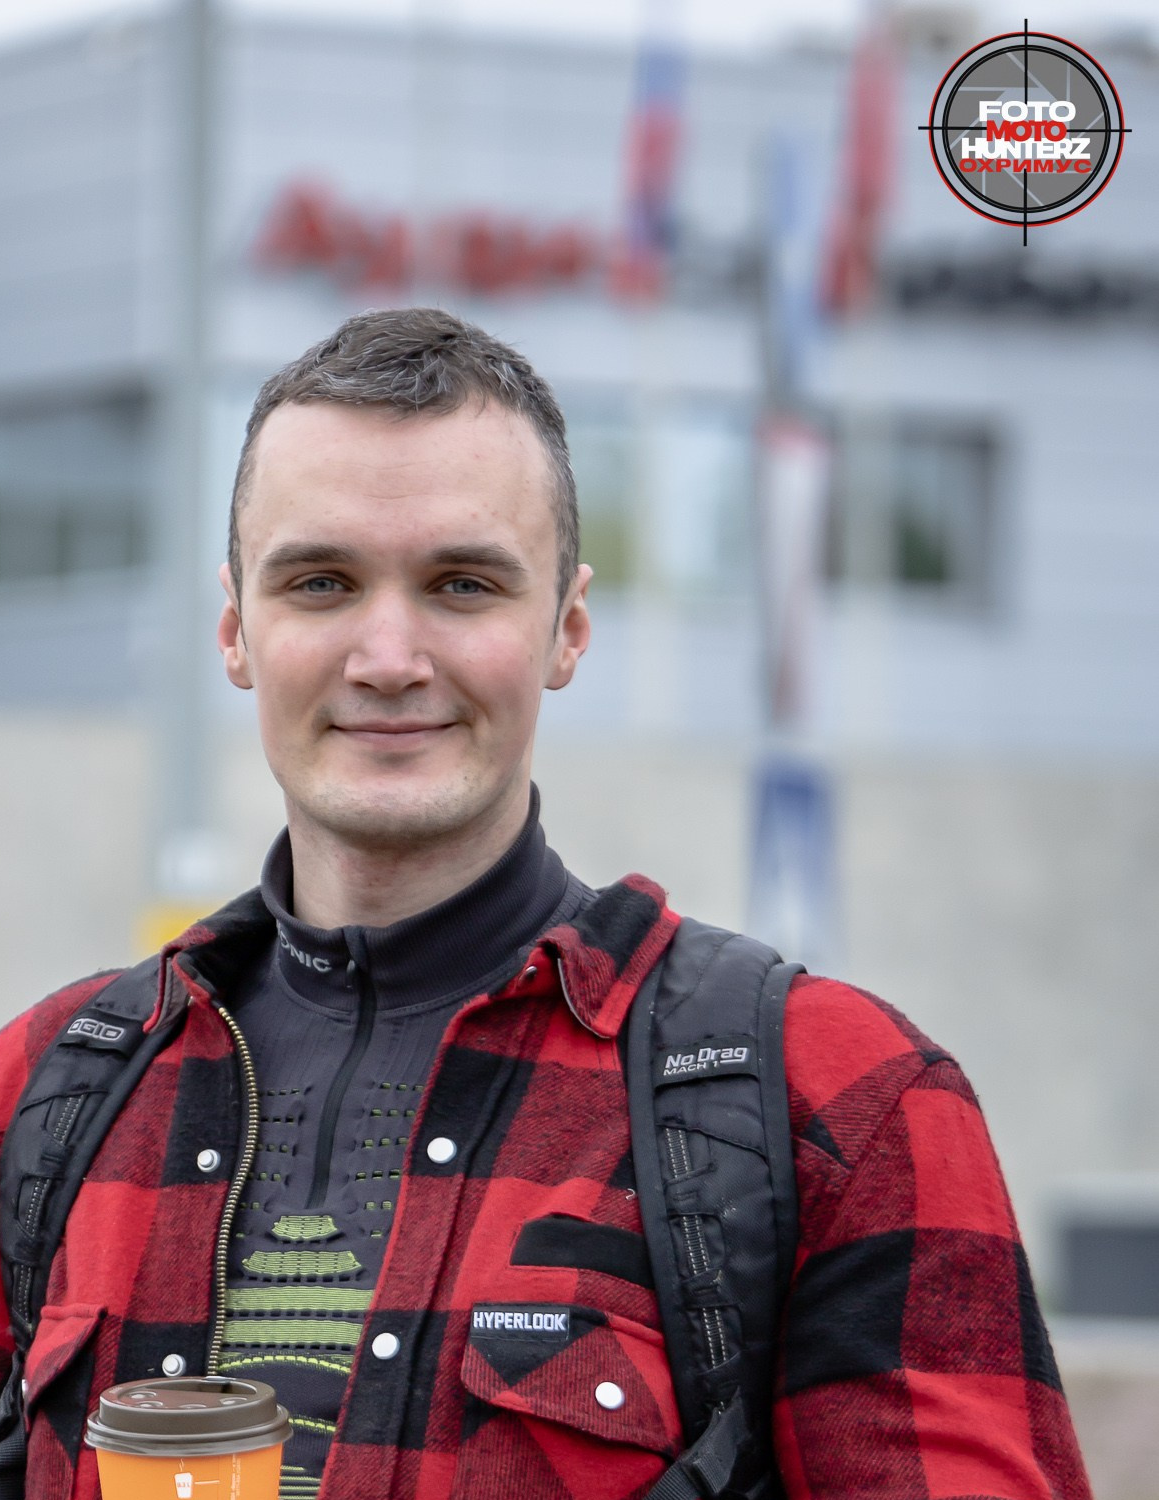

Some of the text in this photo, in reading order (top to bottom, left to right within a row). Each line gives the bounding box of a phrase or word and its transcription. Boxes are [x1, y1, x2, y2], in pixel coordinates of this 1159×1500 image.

[663, 1060, 719, 1076] MACH 1
[665, 1047, 748, 1069] No Drag
[473, 1311, 567, 1331] HYPERLOOK
